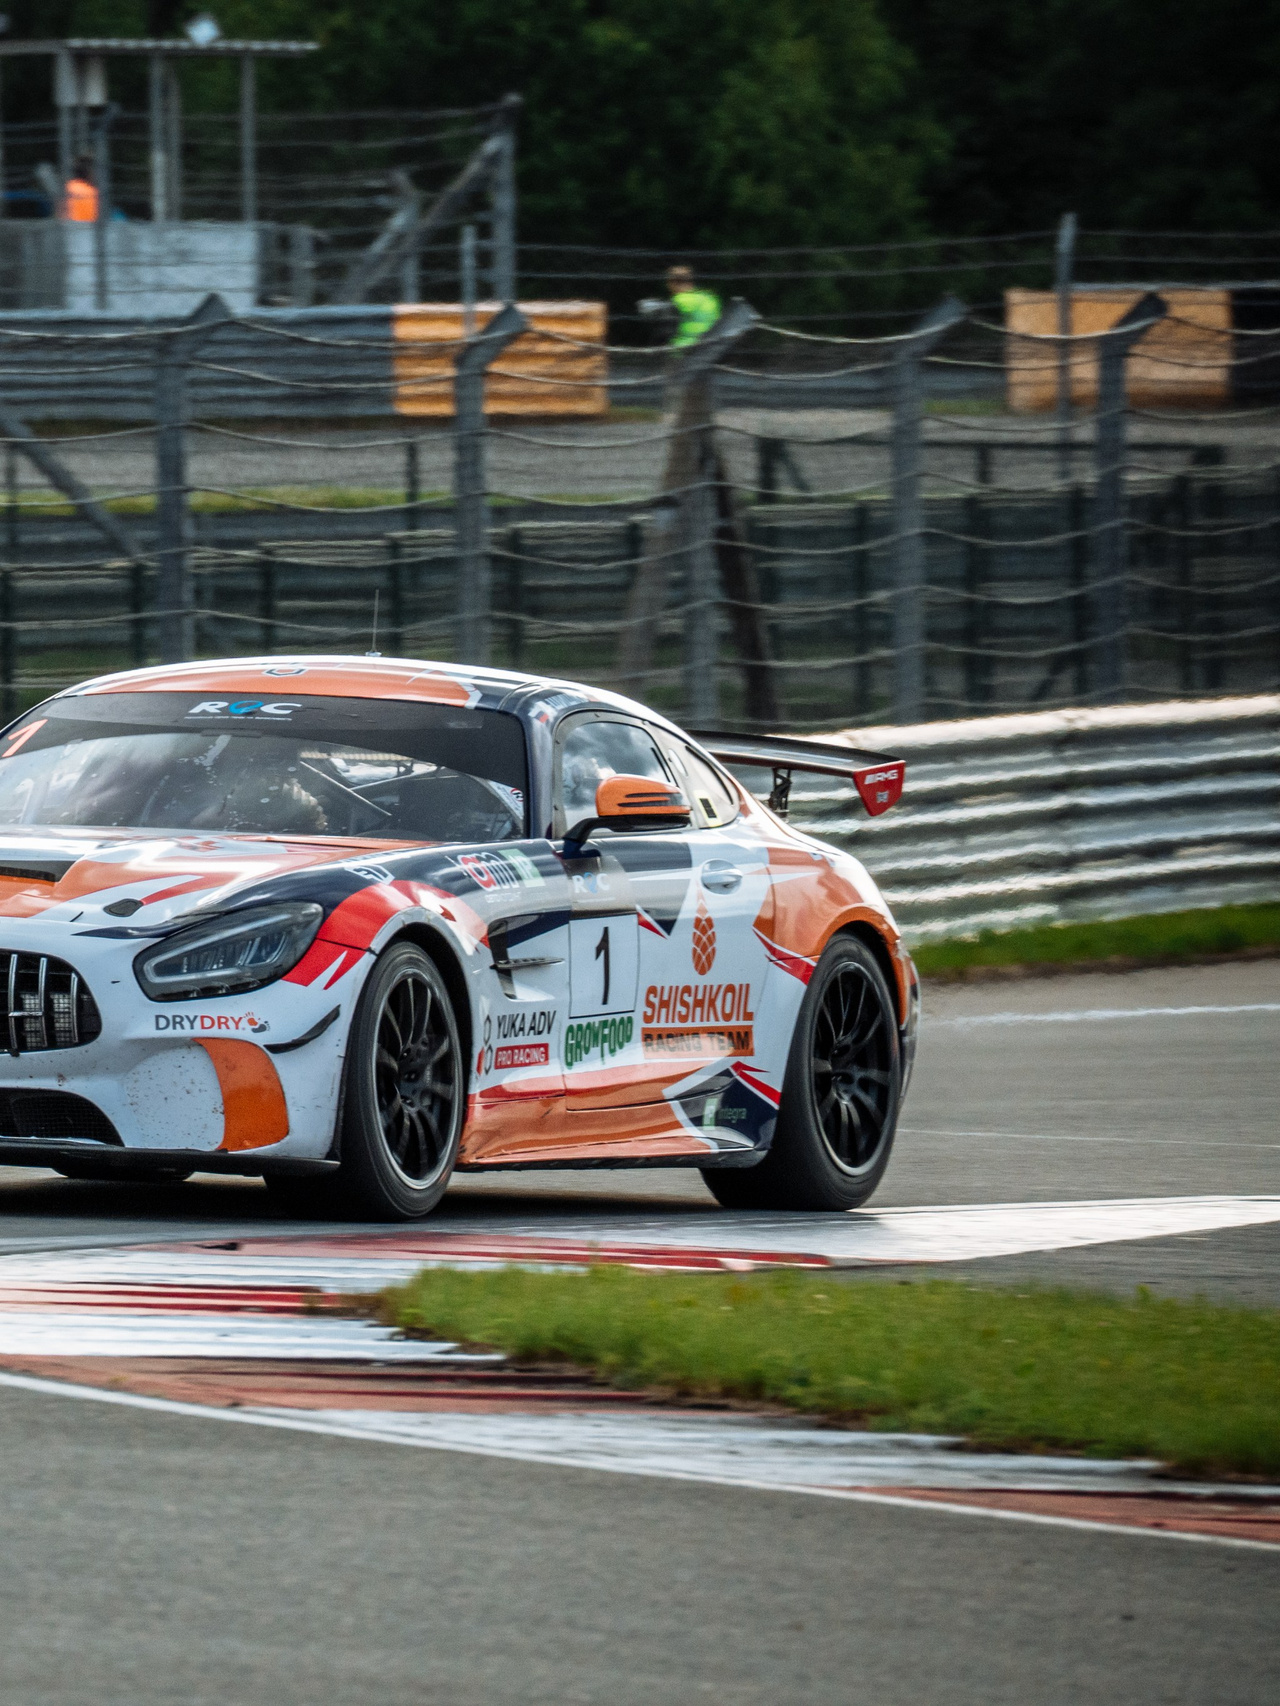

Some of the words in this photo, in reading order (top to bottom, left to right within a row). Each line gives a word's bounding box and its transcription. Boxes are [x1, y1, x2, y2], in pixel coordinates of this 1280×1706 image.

[1, 719, 48, 758] 1
[595, 926, 610, 1006] 1
[643, 983, 754, 1024] SHISHKOIL
[154, 1014, 243, 1030] DRYDRY
[497, 1013, 525, 1039] YUKA
[527, 1010, 557, 1036] ADV
[706, 1031, 750, 1050] TEAM
[497, 1050, 513, 1066] PRO
[513, 1047, 546, 1064] RACING
